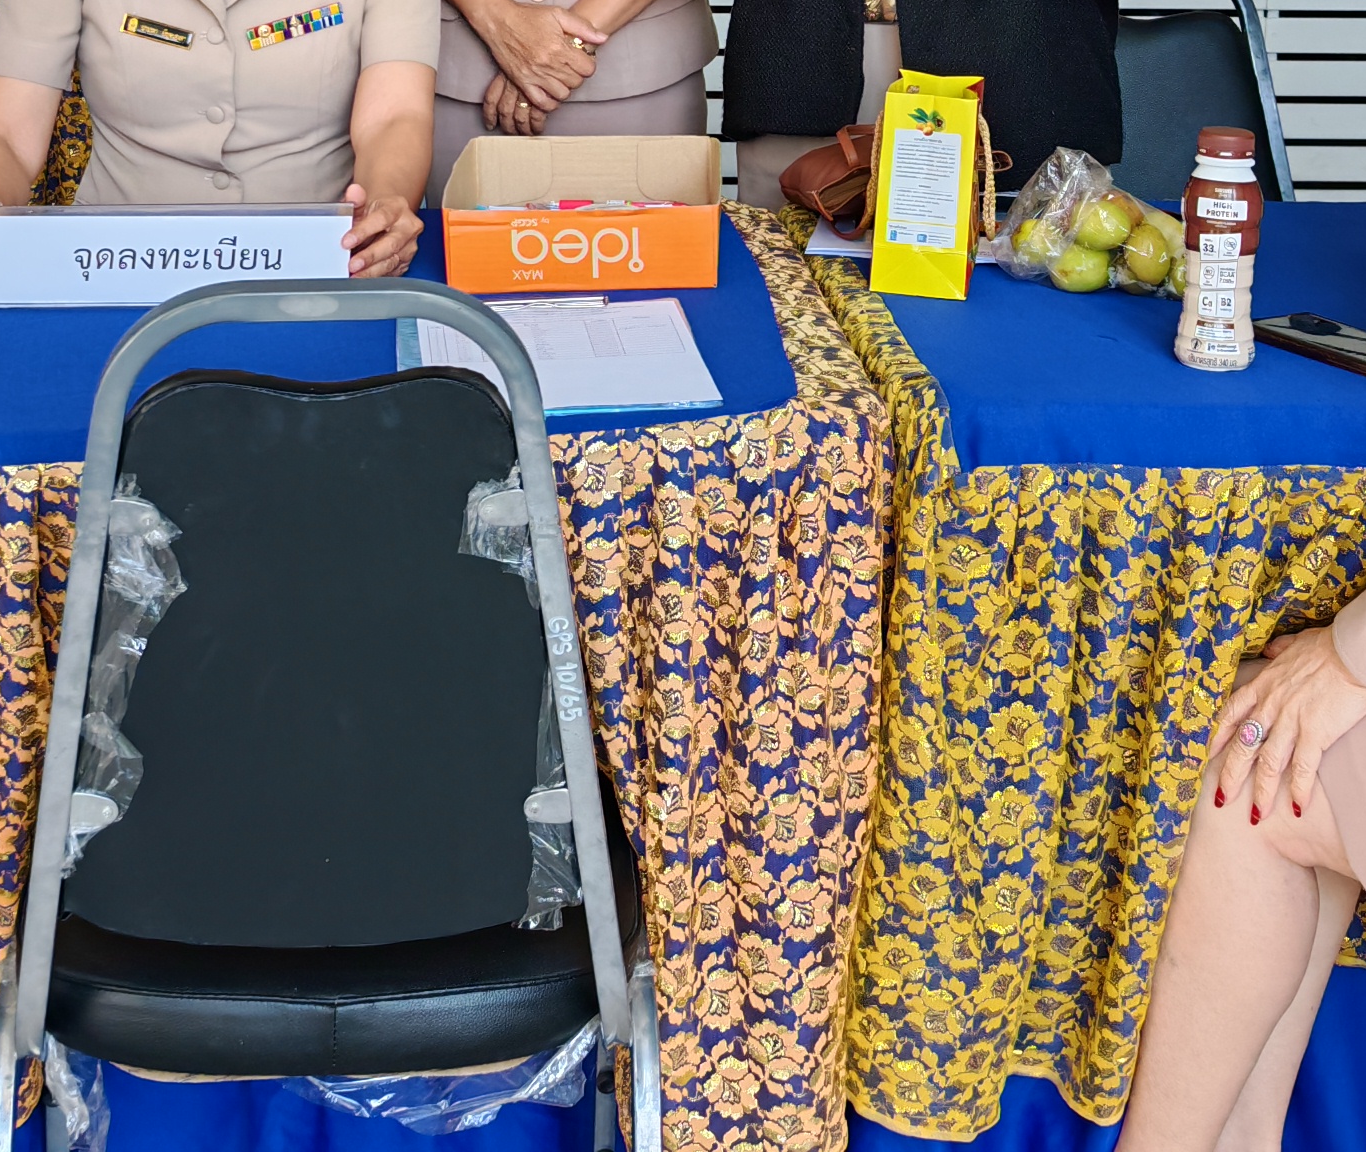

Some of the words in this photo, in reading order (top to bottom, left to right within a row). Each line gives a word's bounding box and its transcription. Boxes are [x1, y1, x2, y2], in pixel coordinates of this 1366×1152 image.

[1206, 209, 1239, 218] PROTEIN
[1213, 201, 1233, 210] HIGH
[72, 235, 283, 282] จุดลงทะเบียน
[511, 227, 645, 279] idea
[512, 269, 544, 281] MAX
[547, 616, 574, 655] GPS
